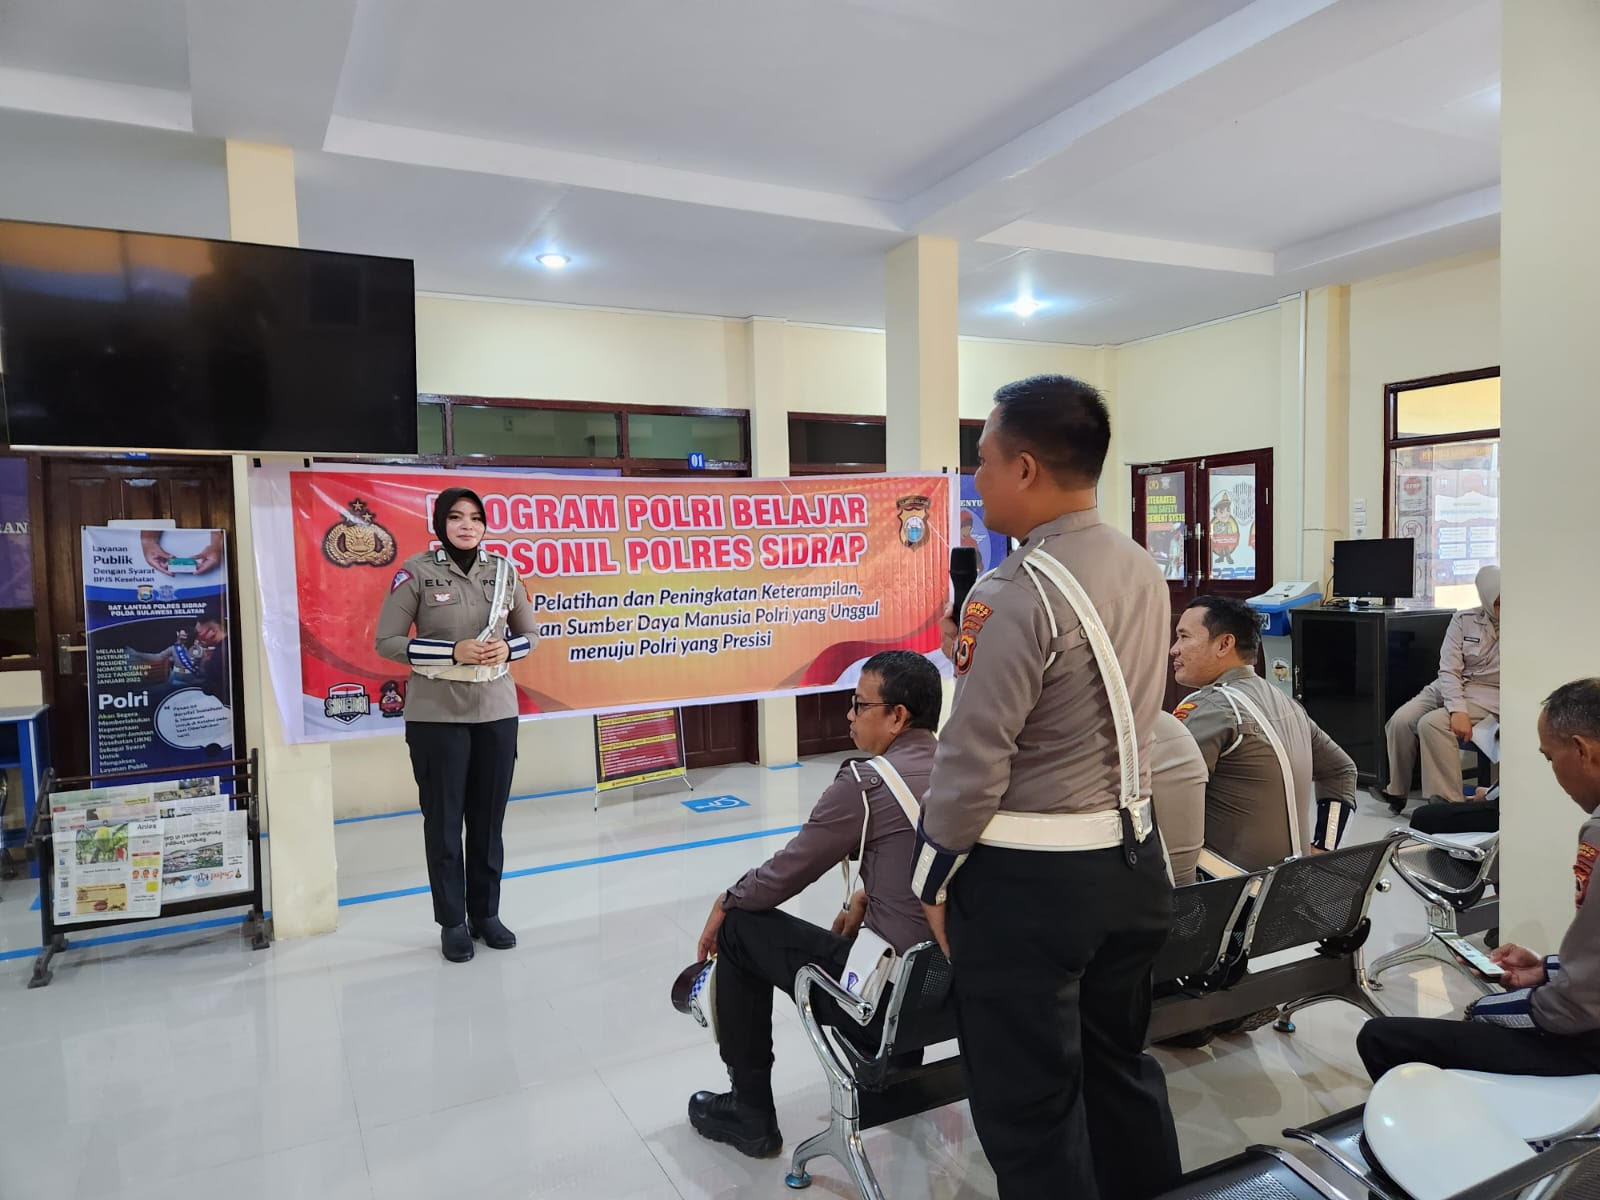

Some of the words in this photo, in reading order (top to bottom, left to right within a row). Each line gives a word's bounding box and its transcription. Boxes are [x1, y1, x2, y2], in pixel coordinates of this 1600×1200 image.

[691, 453, 703, 467] 01
[428, 496, 617, 531] OGRAM
[626, 497, 724, 530] POLRI
[732, 496, 867, 528] BELAJAR
[93, 545, 128, 553] Layanan
[627, 537, 753, 573] POLRES
[761, 534, 866, 568] SIDRAP
[93, 555, 133, 565] Publik
[93, 567, 125, 576] Dengan
[128, 567, 156, 576] Syarat
[424, 579, 453, 587] ELY
[482, 579, 512, 587] POI
[534, 592, 618, 612] Pelatihan
[623, 590, 655, 607] dan
[659, 586, 757, 606] Peningkatan
[761, 581, 862, 600] Keterampilan,
[539, 623, 563, 637] an
[567, 616, 633, 636] Sumber
[637, 614, 680, 633] Daya
[684, 609, 751, 628] Manusia
[755, 606, 788, 623] Polri
[791, 608, 826, 624] yang
[830, 601, 880, 620] Unggul
[570, 641, 634, 661] menuju
[639, 637, 677, 655] Polri
[680, 636, 718, 655] yang
[723, 631, 772, 649] Presisi
[98, 690, 149, 710] Polri
